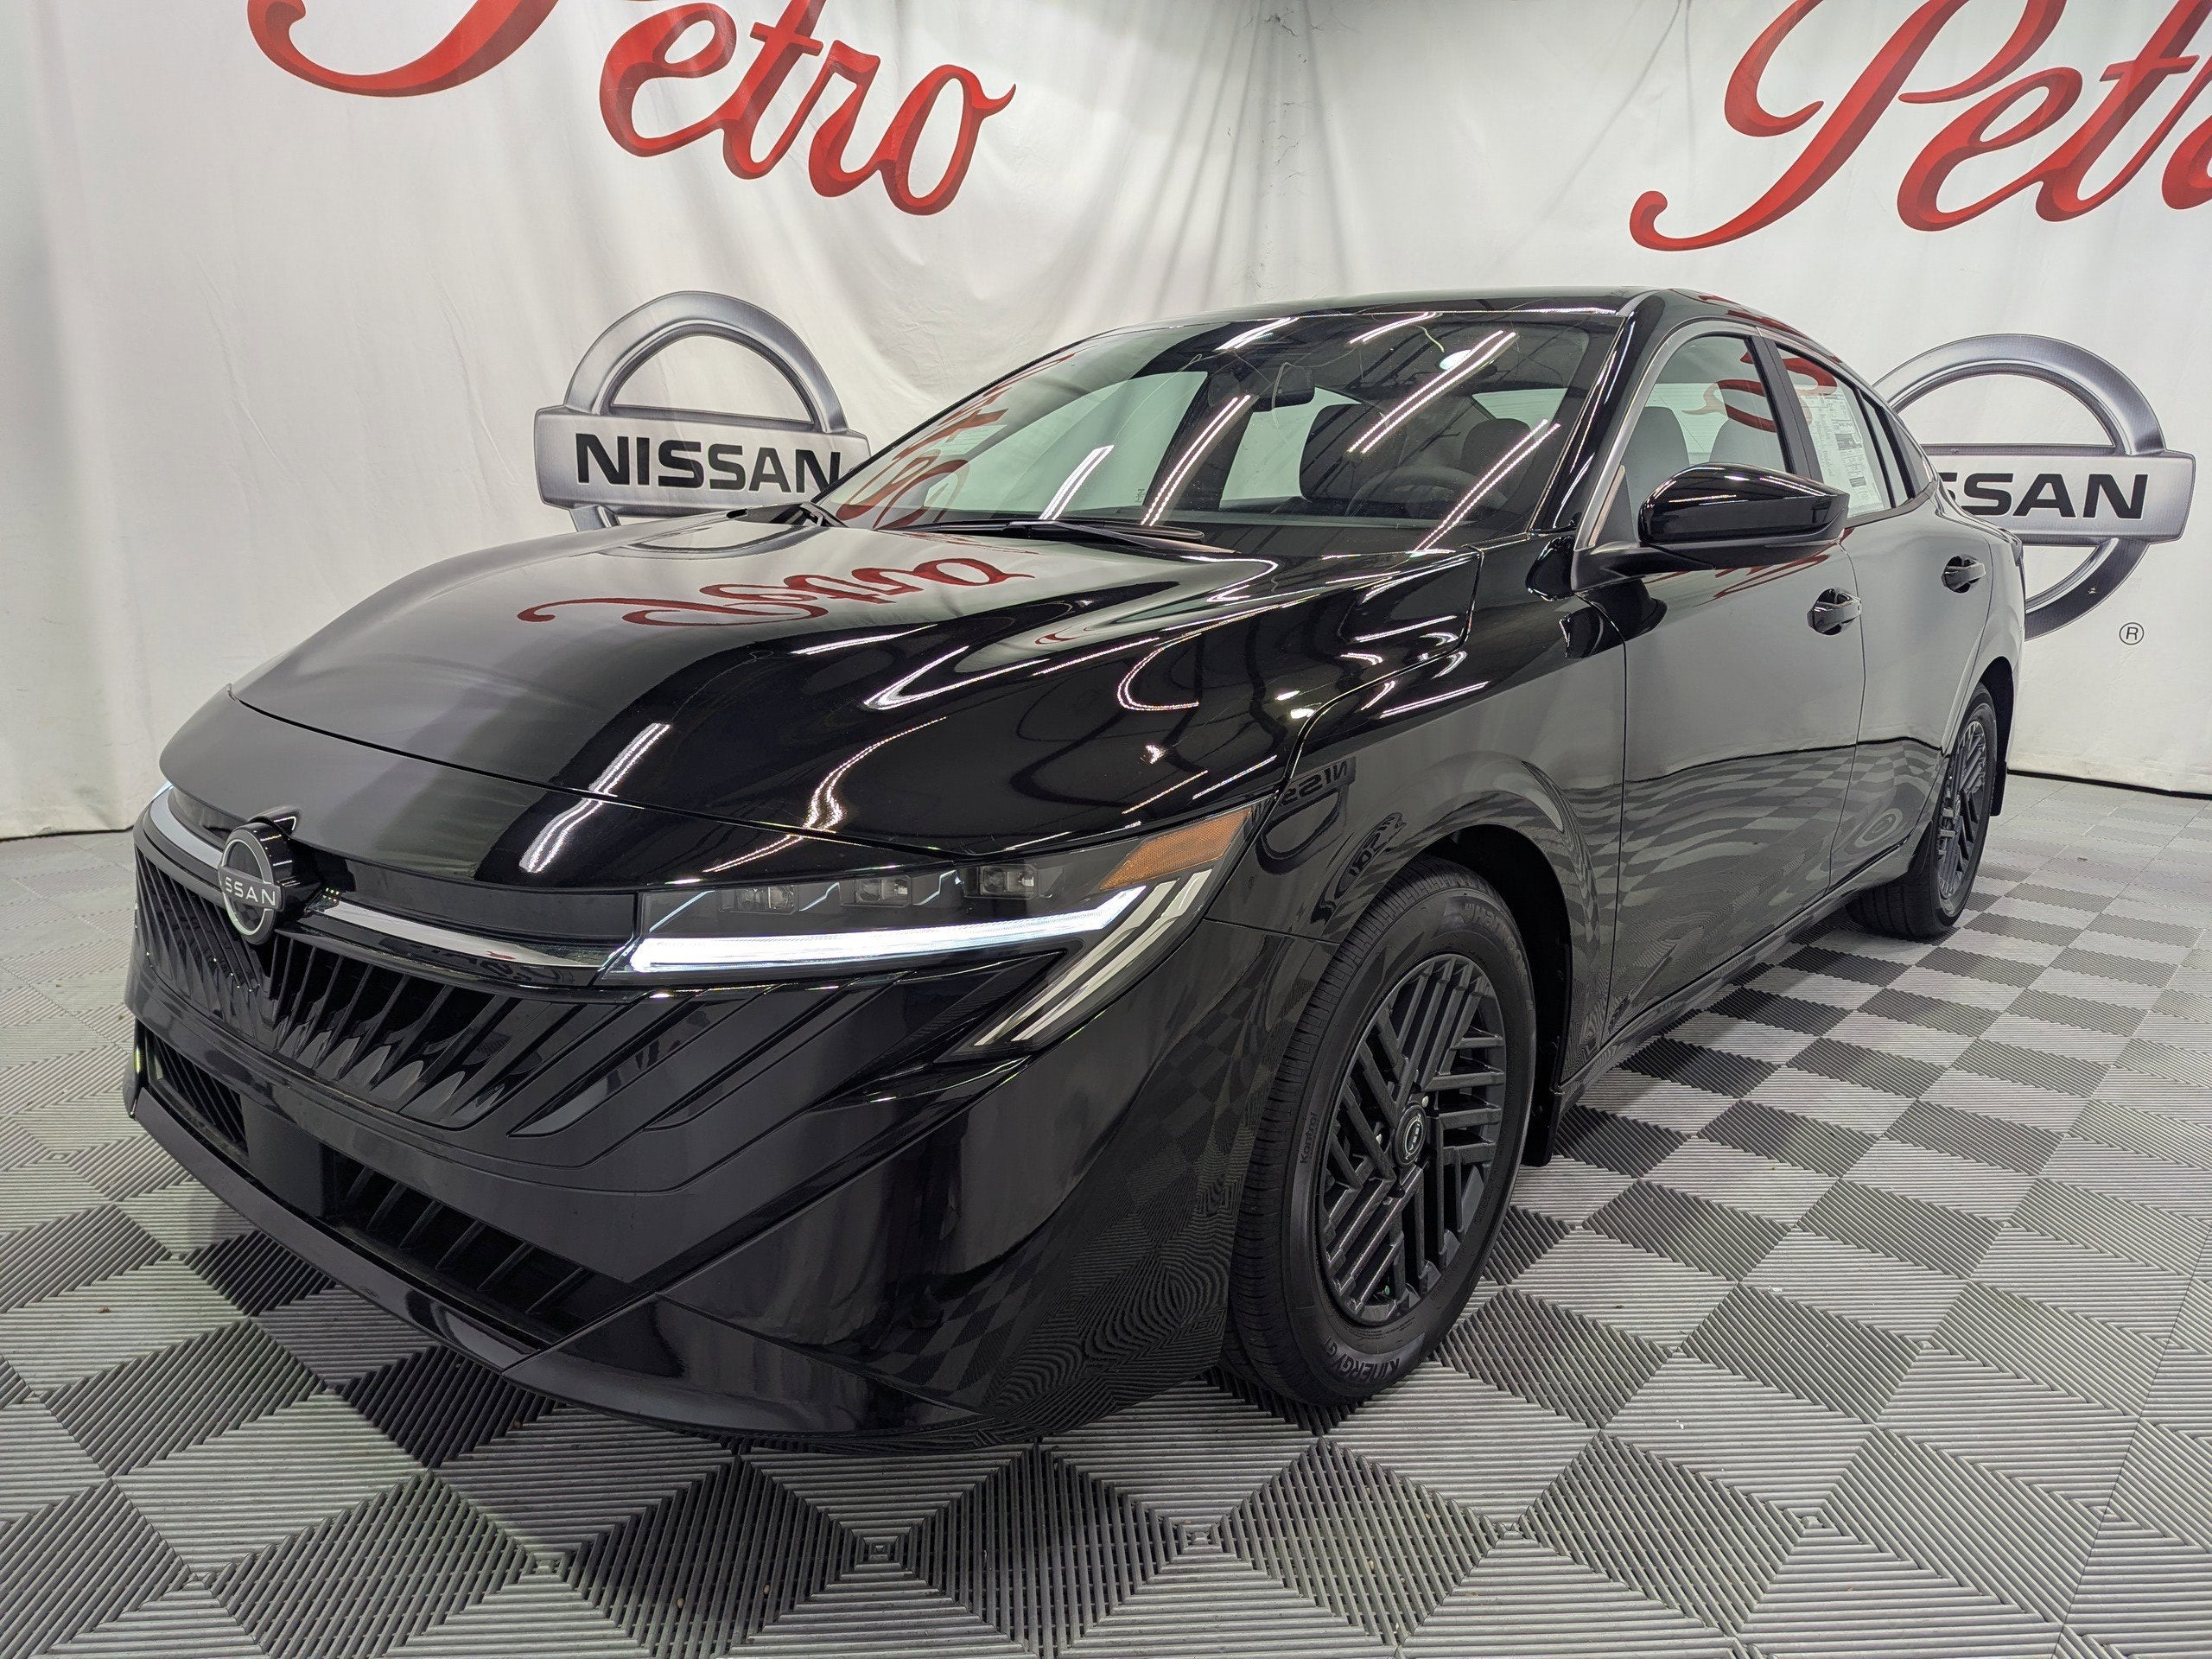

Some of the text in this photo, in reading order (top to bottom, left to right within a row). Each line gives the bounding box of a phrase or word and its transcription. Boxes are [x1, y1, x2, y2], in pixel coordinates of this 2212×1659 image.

[1630, 0, 2212, 251] Pet
[575, 433, 842, 493] NISSAN
[1938, 472, 2149, 520] SAN
[225, 876, 276, 906] SSAN
